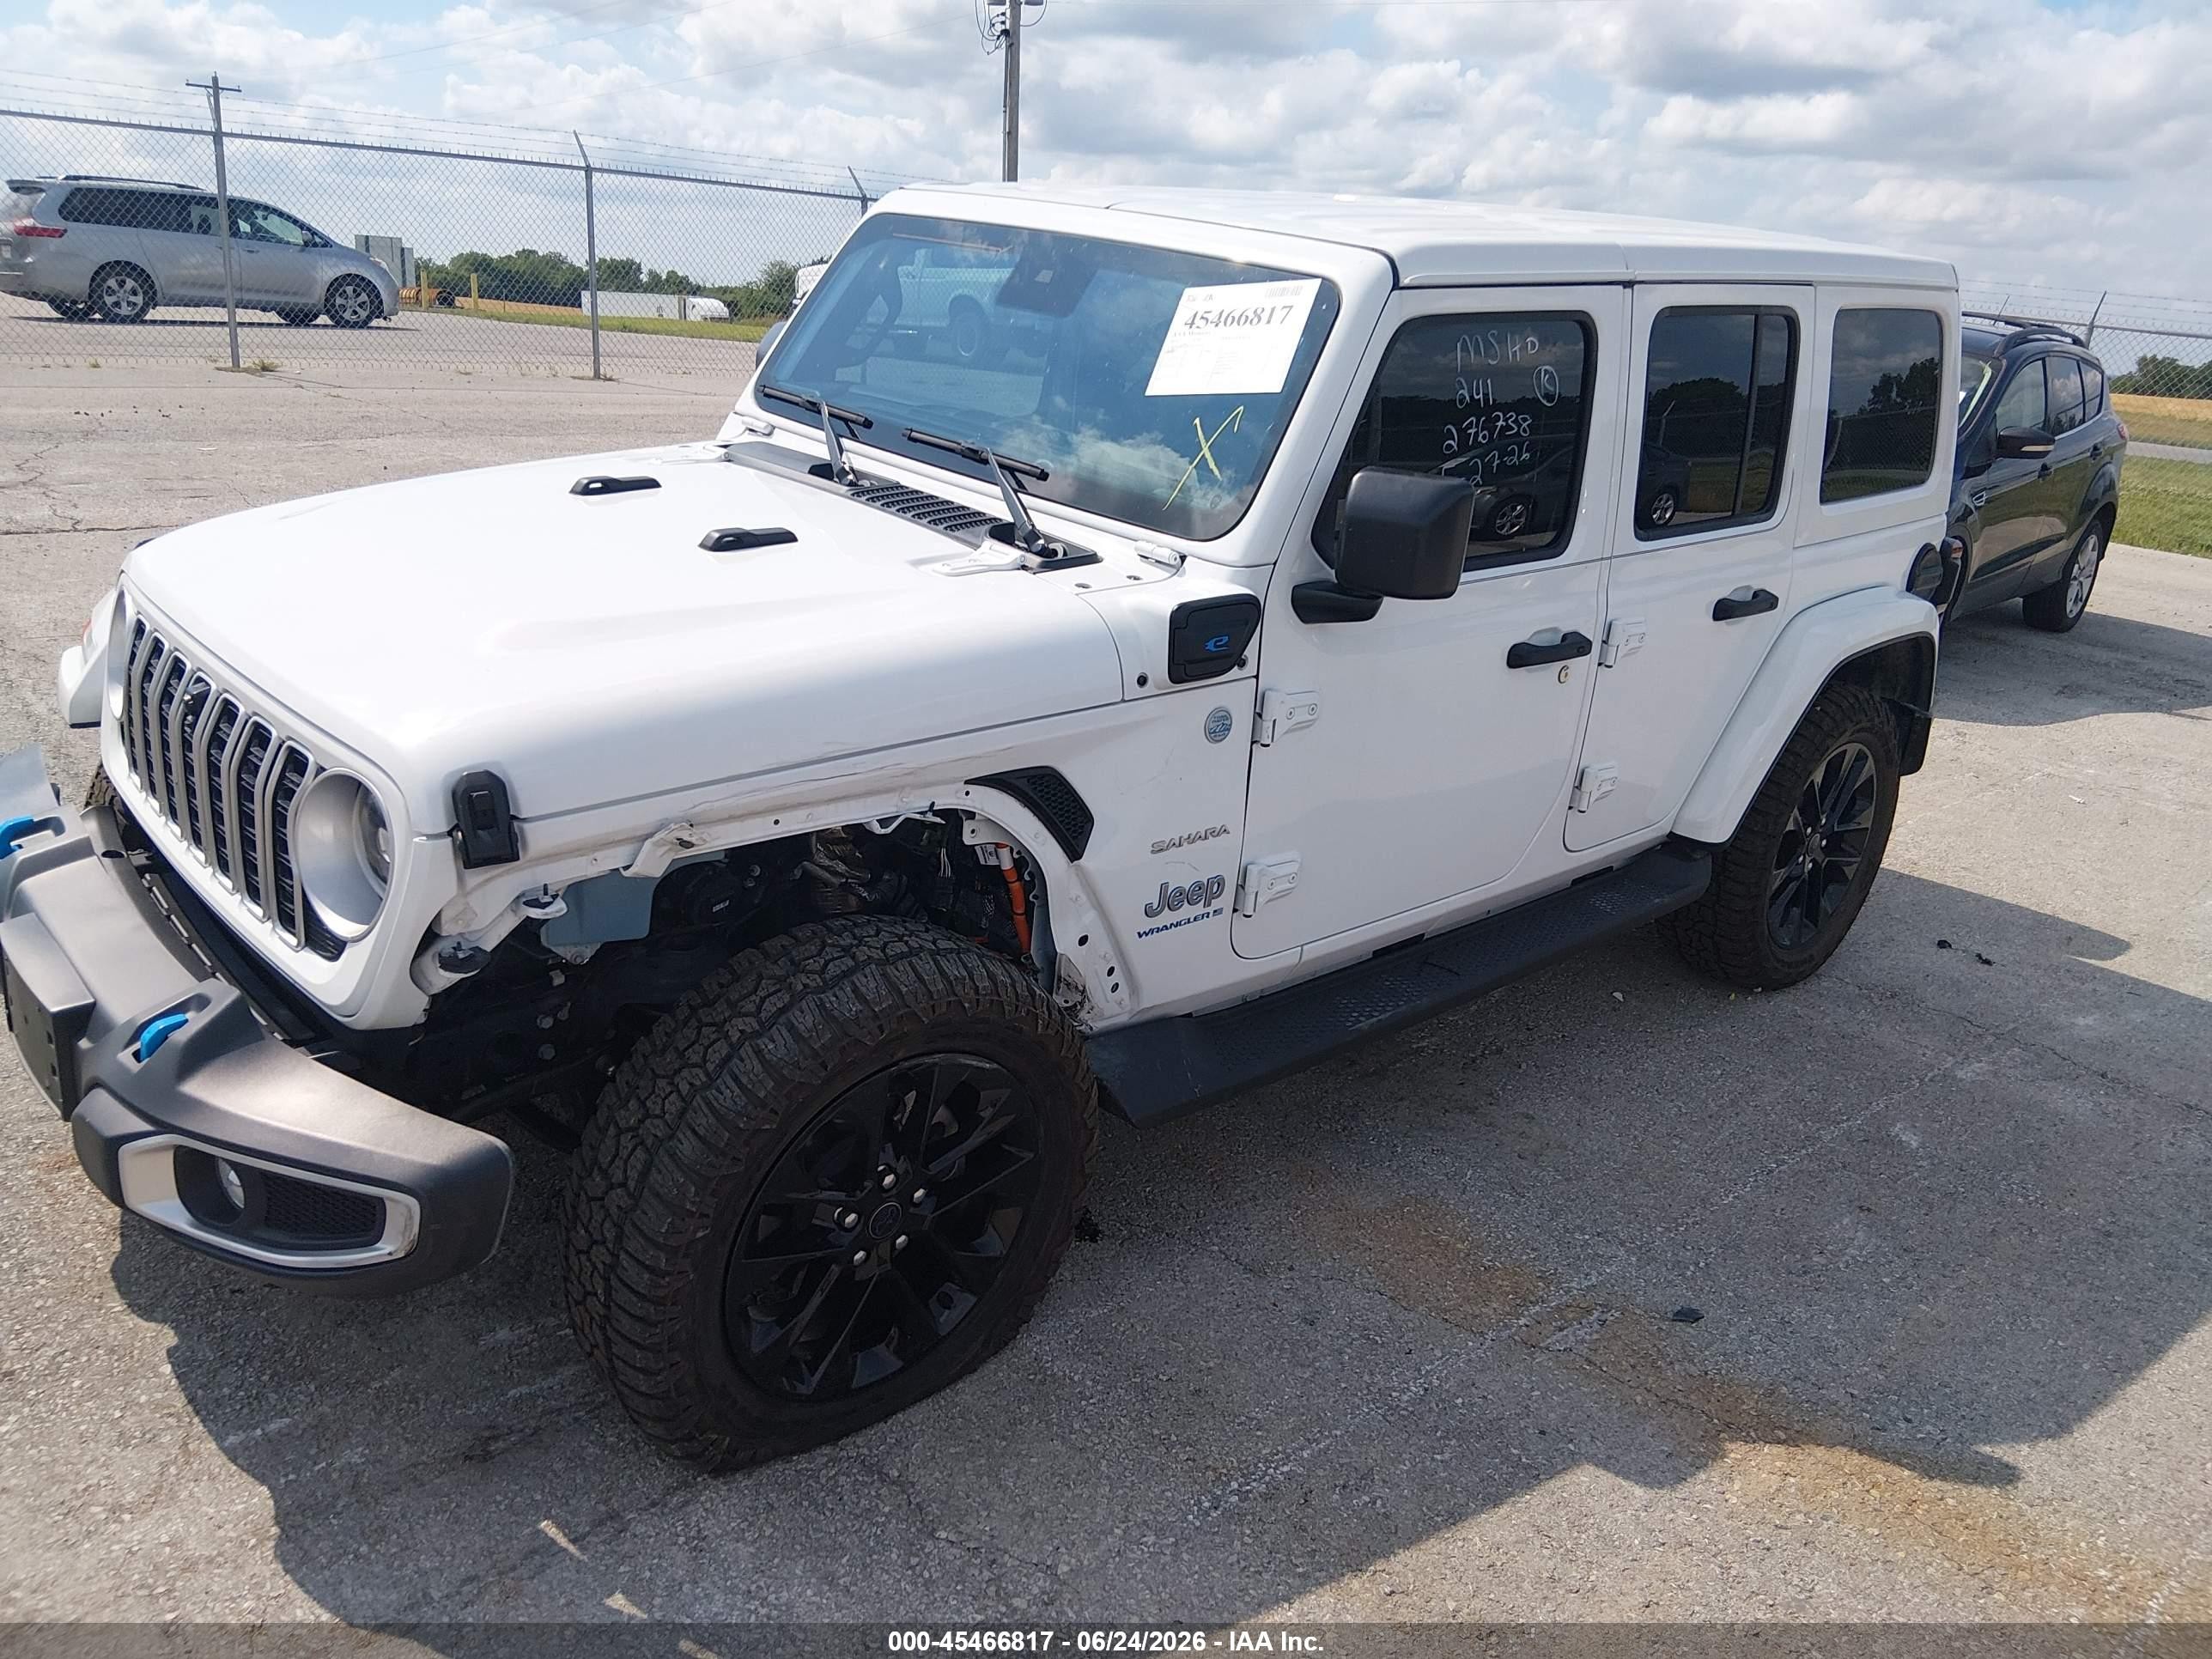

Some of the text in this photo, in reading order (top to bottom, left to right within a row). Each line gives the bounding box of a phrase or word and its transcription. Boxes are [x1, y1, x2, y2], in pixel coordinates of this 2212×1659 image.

[1183, 305, 1294, 331] 45466817
[1455, 377, 1493, 409] 241
[1150, 824, 1231, 854] SAHARA
[1144, 874, 1226, 919] Jeep
[1136, 910, 1211, 939] WRANGLER
